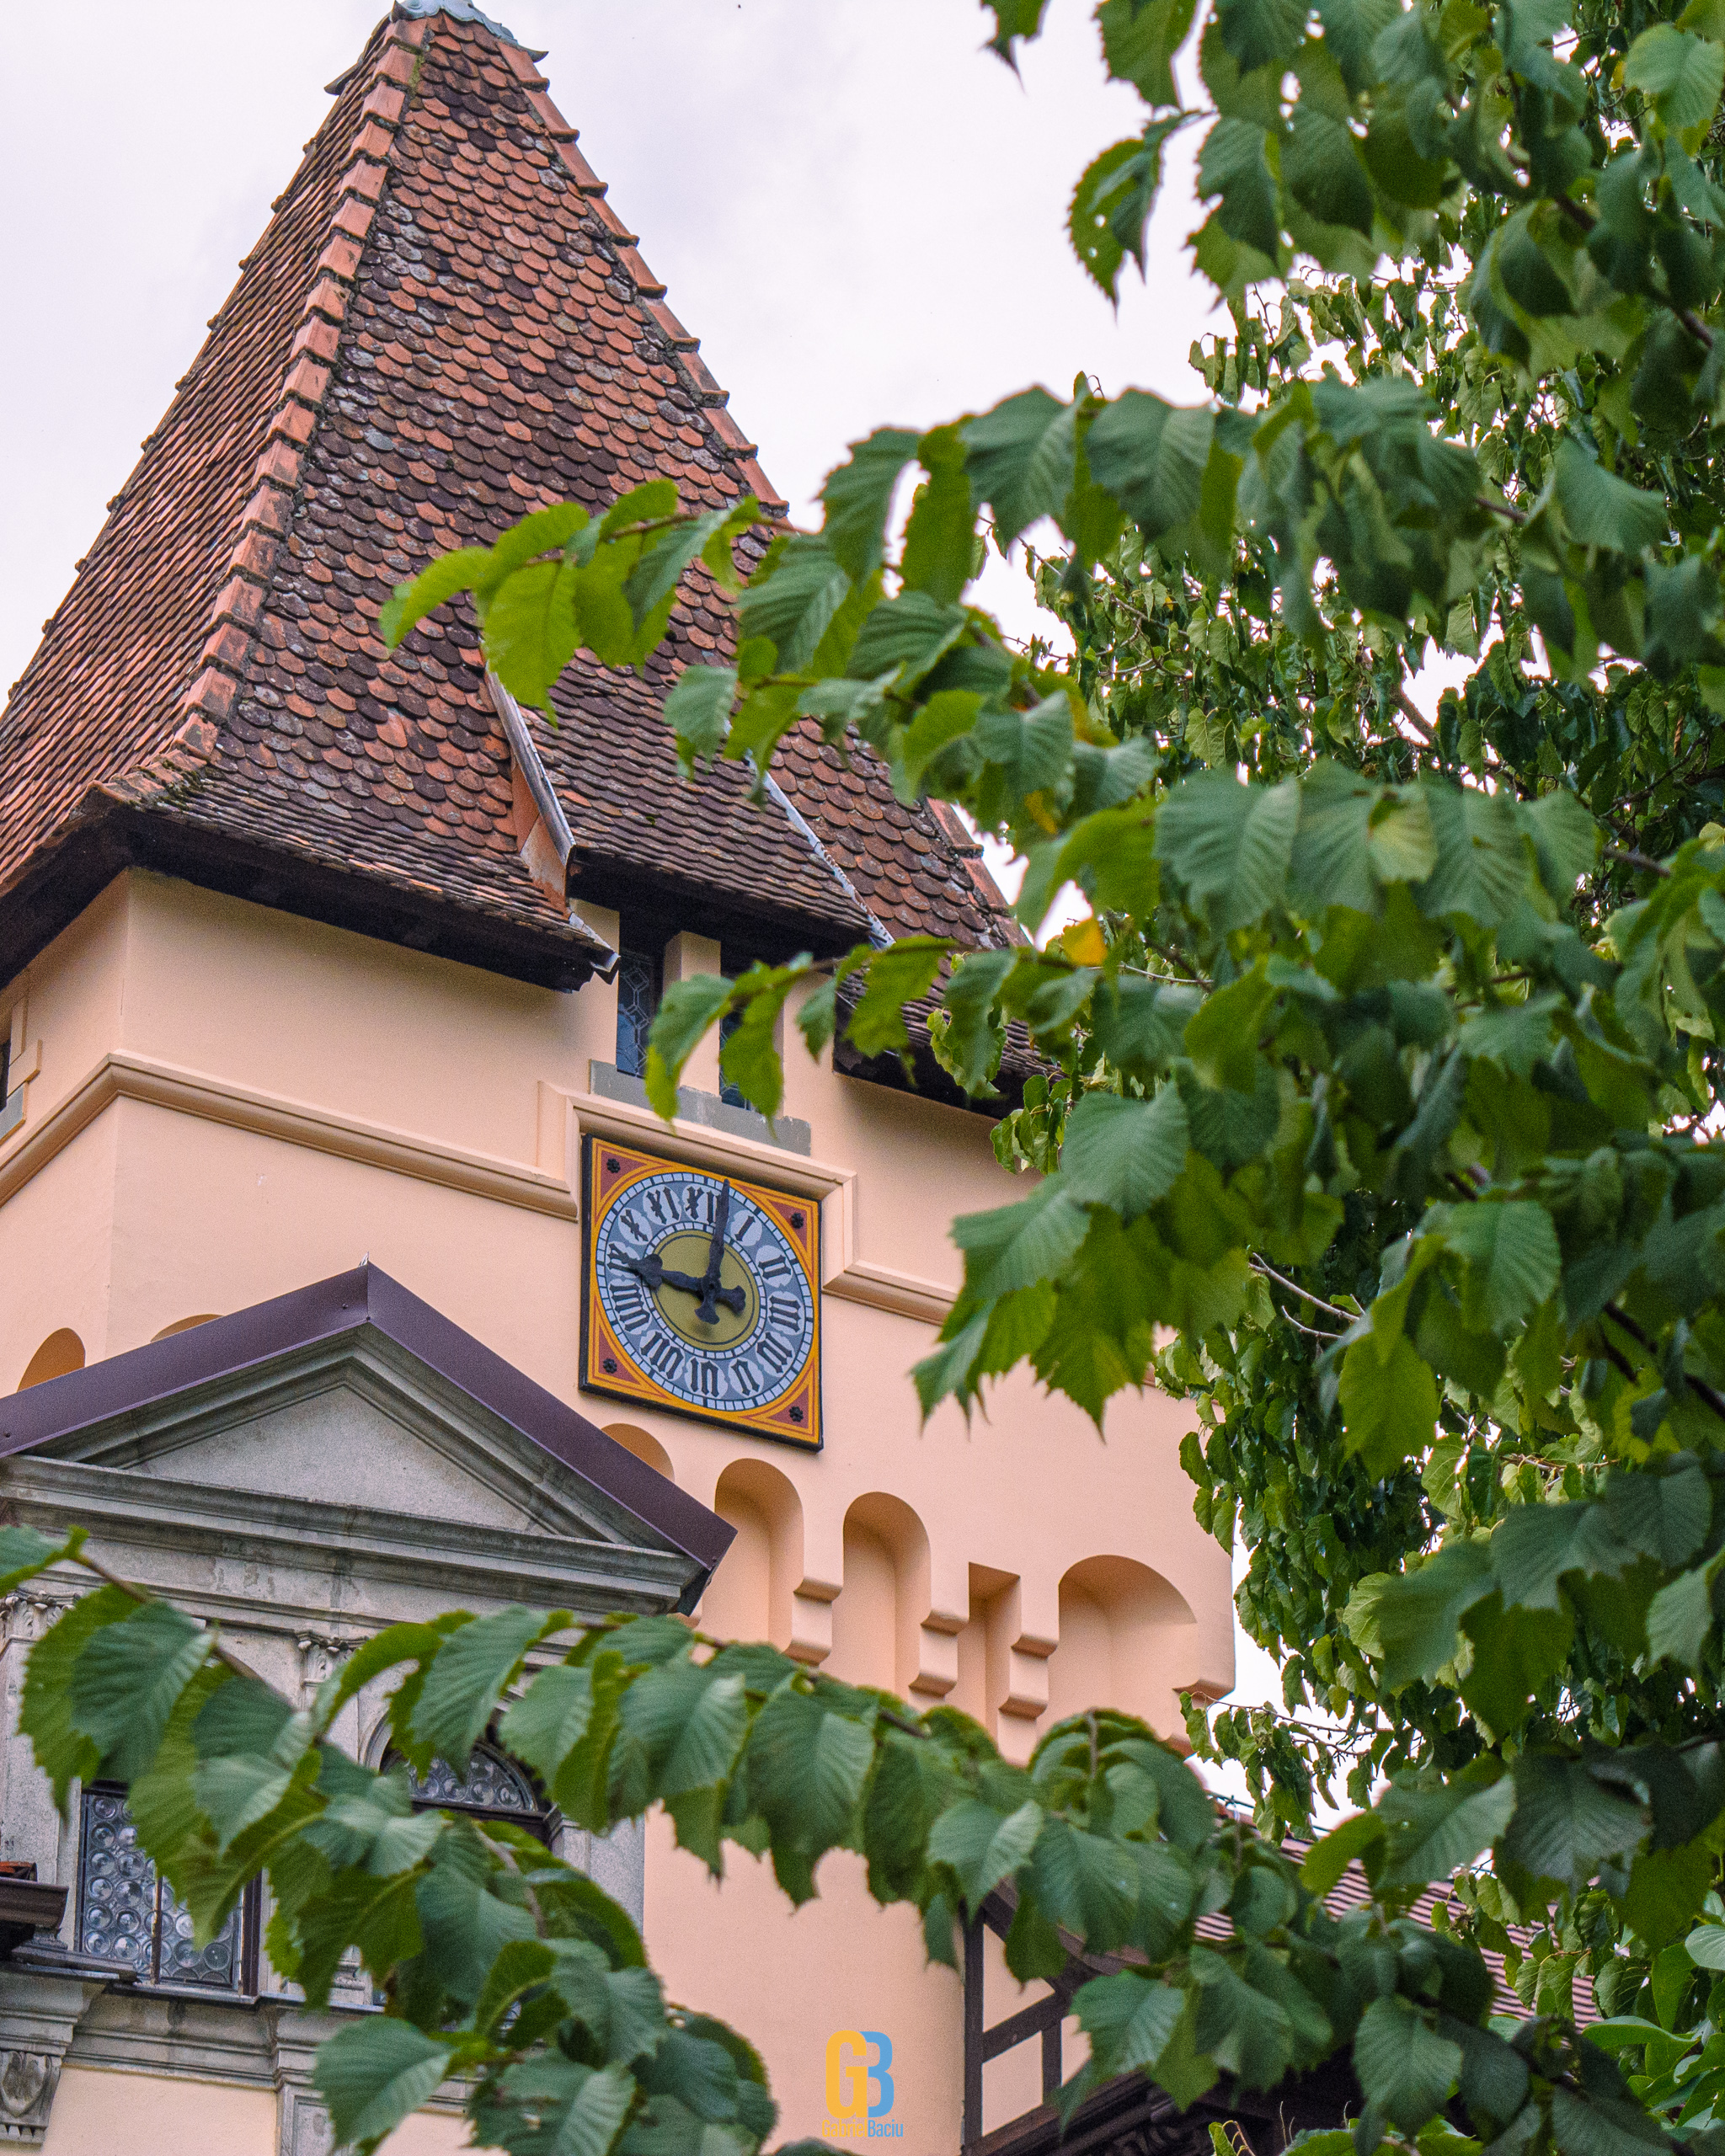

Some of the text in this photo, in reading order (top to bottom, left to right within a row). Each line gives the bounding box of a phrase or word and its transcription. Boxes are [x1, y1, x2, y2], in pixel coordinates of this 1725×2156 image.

[646, 1187, 680, 1225] XI
[620, 1209, 649, 1241] X
[734, 1215, 756, 1241] I
[758, 1255, 792, 1280] II
[768, 1295, 801, 1332] III
